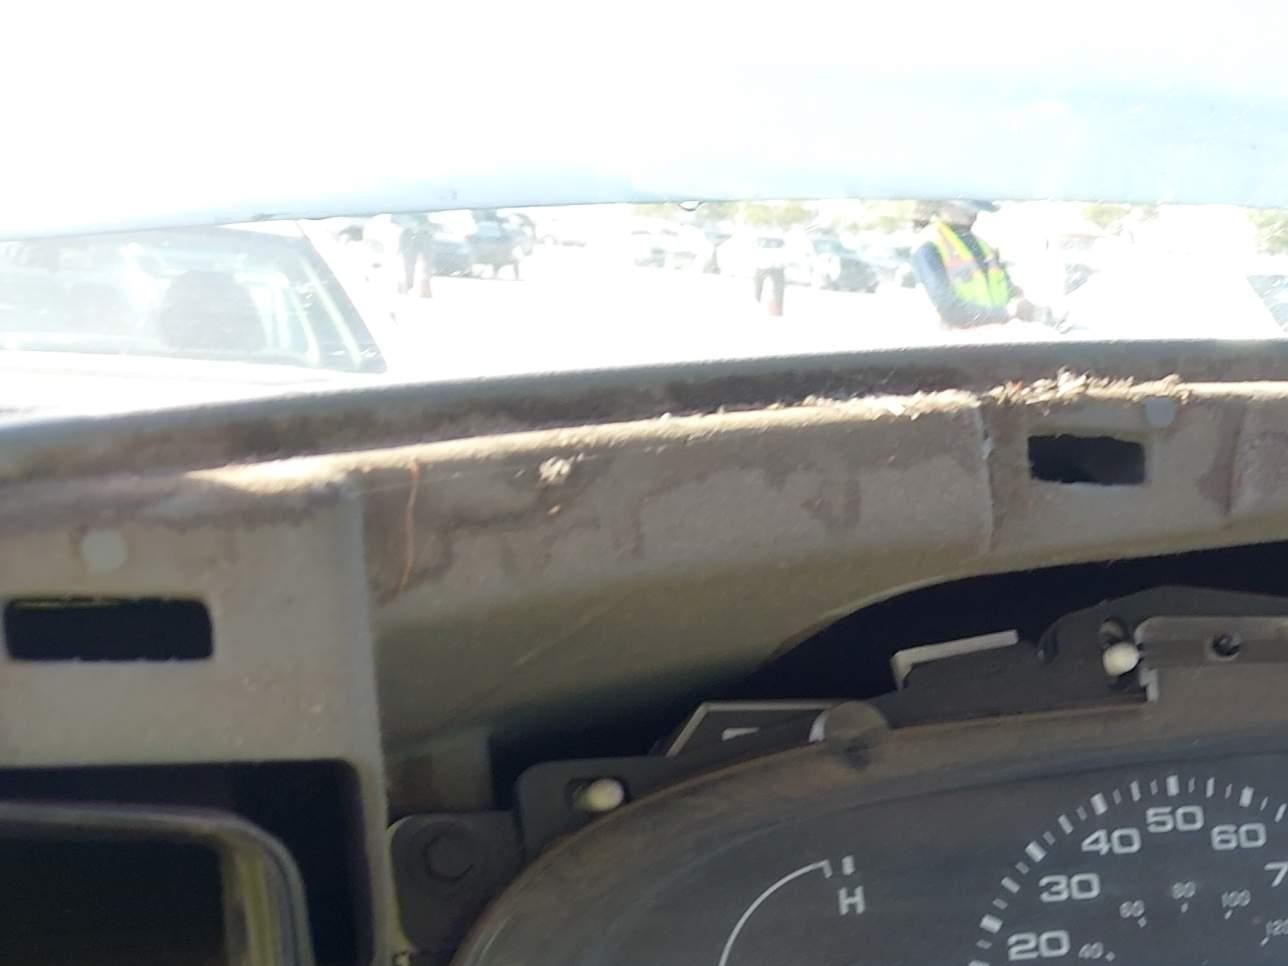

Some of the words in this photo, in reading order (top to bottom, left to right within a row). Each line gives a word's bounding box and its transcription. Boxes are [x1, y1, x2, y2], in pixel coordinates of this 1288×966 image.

[1145, 805, 1205, 833] 50
[1080, 828, 1141, 855] 40
[1210, 822, 1267, 851] 60
[838, 885, 866, 916] H
[1039, 873, 1101, 903] 30
[1007, 930, 1070, 961] 20
